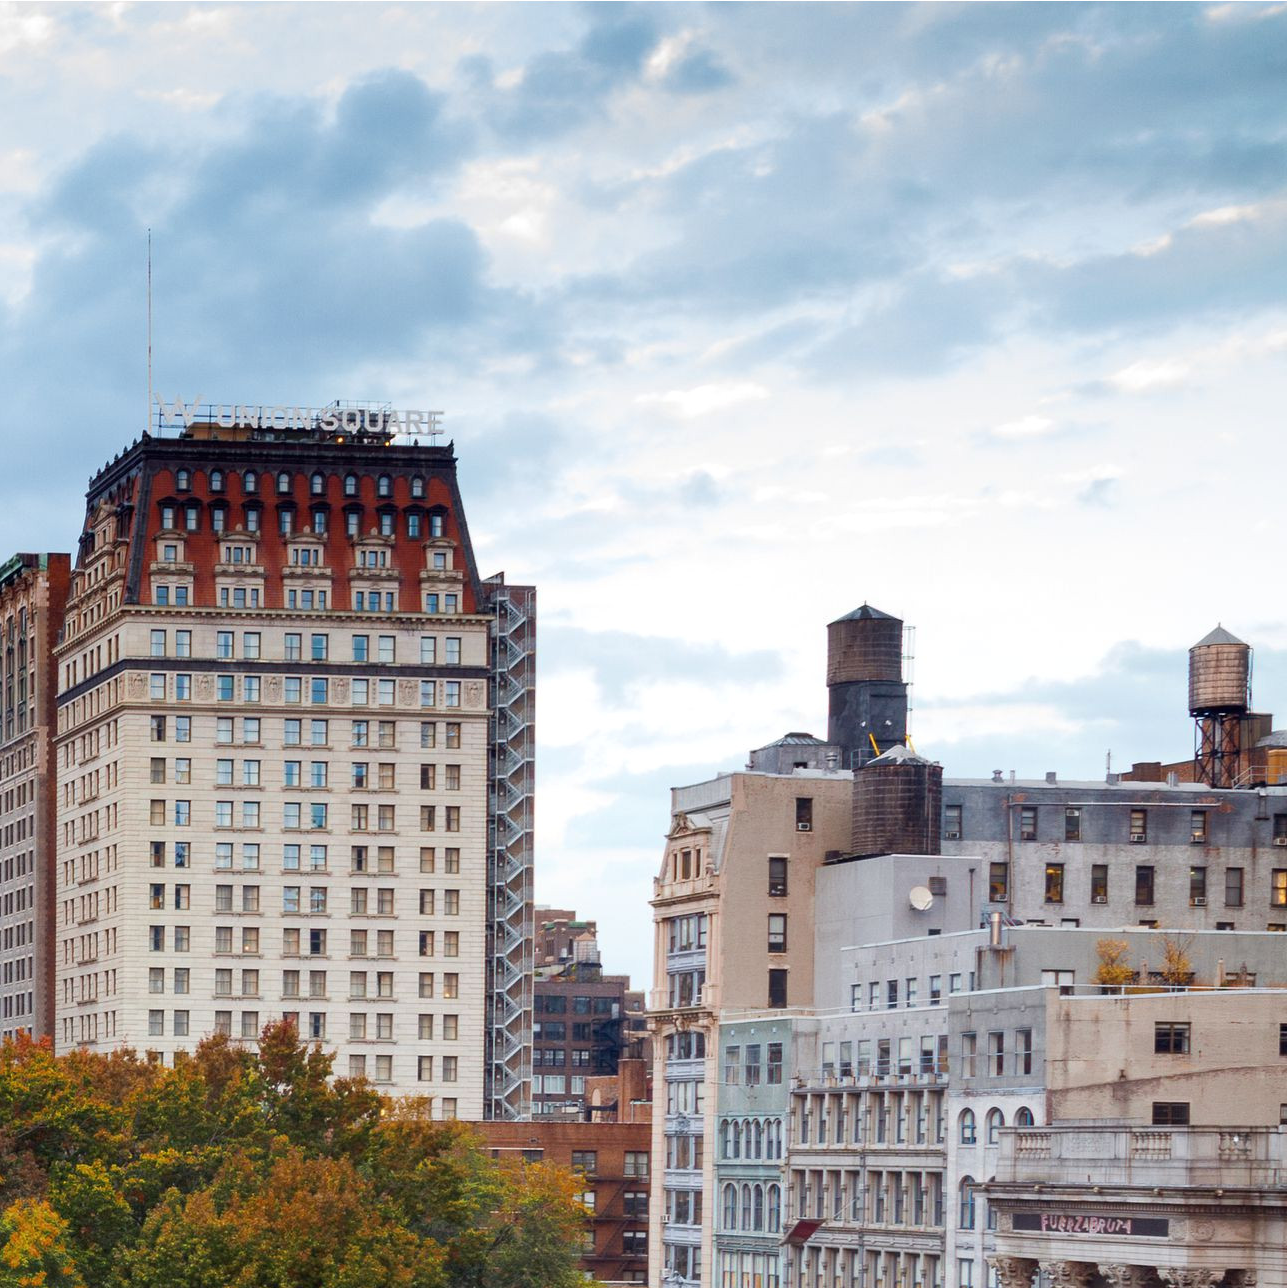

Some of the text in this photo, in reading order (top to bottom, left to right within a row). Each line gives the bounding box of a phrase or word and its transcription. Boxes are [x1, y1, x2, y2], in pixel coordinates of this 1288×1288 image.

[154, 392, 446, 434] W UNION SQUARE
